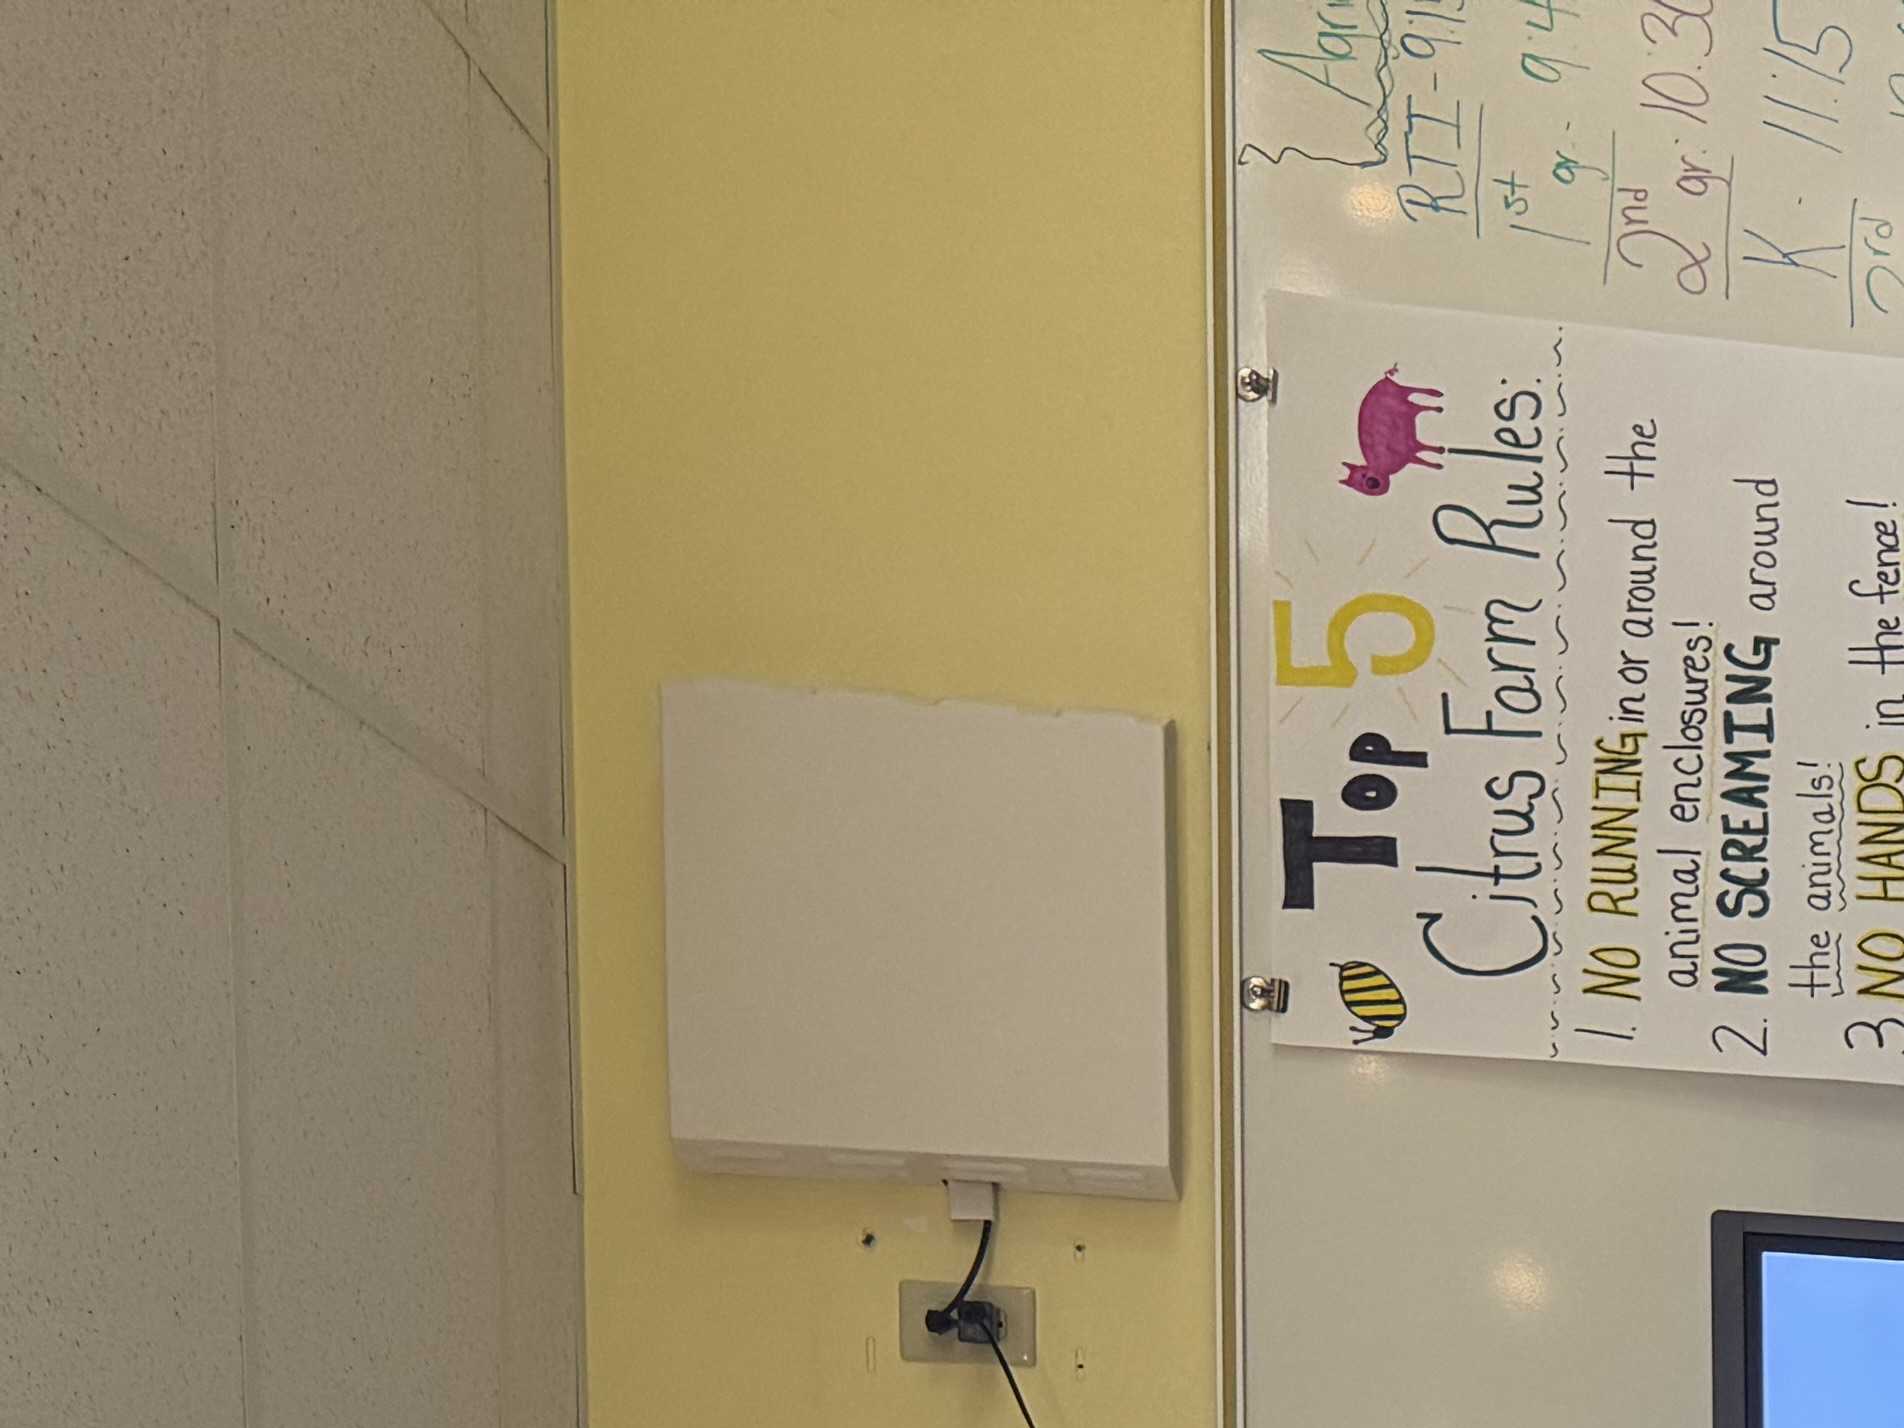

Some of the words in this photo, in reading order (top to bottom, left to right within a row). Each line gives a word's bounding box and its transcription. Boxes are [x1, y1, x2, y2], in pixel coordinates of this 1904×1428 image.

[1742, 228, 1845, 278] K
[1433, 377, 1544, 558] Rules:
[1605, 419, 1657, 488] the
[1606, 519, 1658, 638] around
[1734, 478, 1780, 611] around
[1845, 501, 1904, 602] fence!
[1273, 593, 1436, 689] 5
[1442, 599, 1544, 739] Farm
[1614, 651, 1649, 684] or
[1852, 616, 1903, 674] the
[1607, 693, 1647, 722] in
[1661, 620, 1713, 823] enclosures!
[1281, 732, 1428, 909] Top
[1586, 731, 1648, 916] RUNNING
[1719, 636, 1780, 919] SCREAMING
[1797, 761, 1838, 911] animals!
[1416, 771, 1548, 976] Citrus
[1660, 849, 1702, 988] animal
[1582, 947, 1643, 1001] NO
[1713, 943, 1770, 995] NO
[1790, 931, 1834, 997] the
